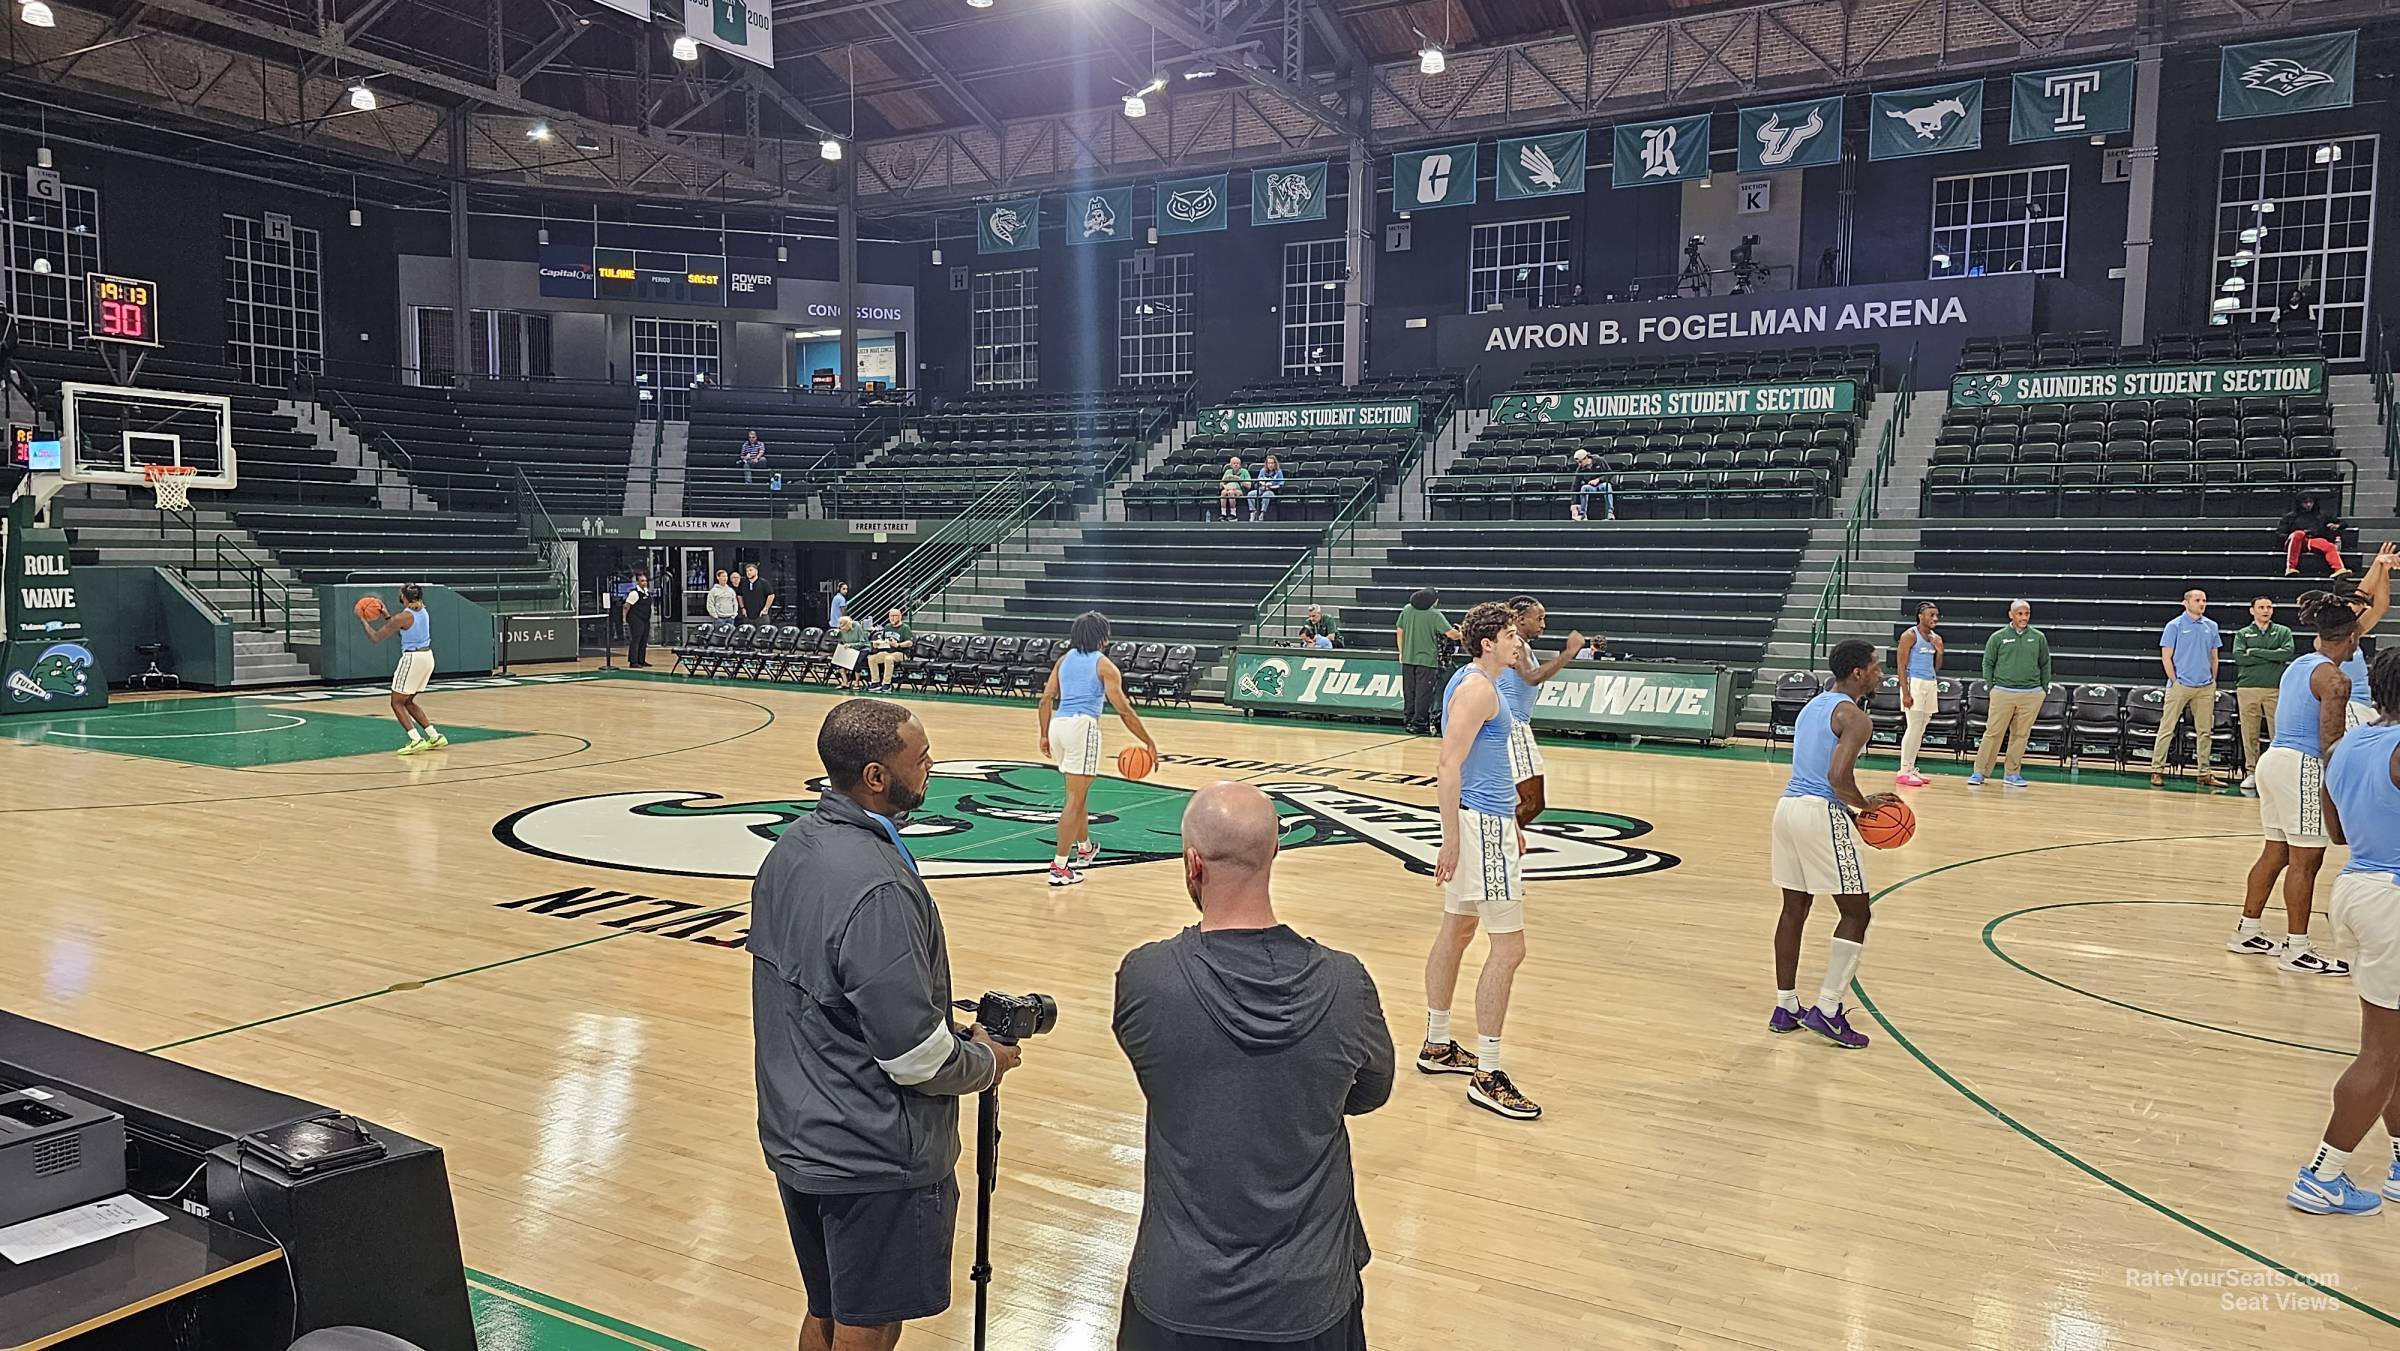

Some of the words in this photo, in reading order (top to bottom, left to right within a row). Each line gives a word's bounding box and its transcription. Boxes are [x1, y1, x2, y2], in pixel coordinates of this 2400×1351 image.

[726, 5, 734, 23] 4
[748, 10, 769, 31] 2000
[2116, 160, 2129, 178] L
[36, 179, 52, 196] G
[1741, 183, 1768, 191] SECTION
[1747, 193, 1761, 210] K
[272, 222, 285, 238] H
[1394, 233, 1401, 248] J
[598, 267, 636, 280] TULANE
[100, 282, 147, 305] 19:13
[102, 301, 142, 336] 30
[1485, 321, 1589, 352] AVRON
[1599, 320, 1628, 346] B.
[1638, 305, 1828, 343] FOGELMAN
[1836, 296, 1968, 331] ARENA
[2017, 375, 2117, 400] SAUNDERS
[2123, 370, 2217, 396] STUDENT
[2222, 367, 2312, 393] SECTION
[1573, 394, 1662, 419] SAUNDERS
[1667, 390, 1750, 415] STUDENT
[1756, 386, 1836, 412] SECTION
[1237, 410, 1297, 429] SAUNDERS
[1300, 408, 1356, 427] STUDENT
[1359, 406, 1412, 425] SECTION
[655, 520, 708, 528] MCALISTER
[710, 521, 731, 529] WAY
[855, 523, 881, 531] FRERET
[883, 523, 909, 531] STREET
[24, 555, 69, 575] ROLL
[21, 588, 76, 609] WAVE
[533, 629, 555, 641] A-E
[1589, 675, 1709, 716] WAVE
